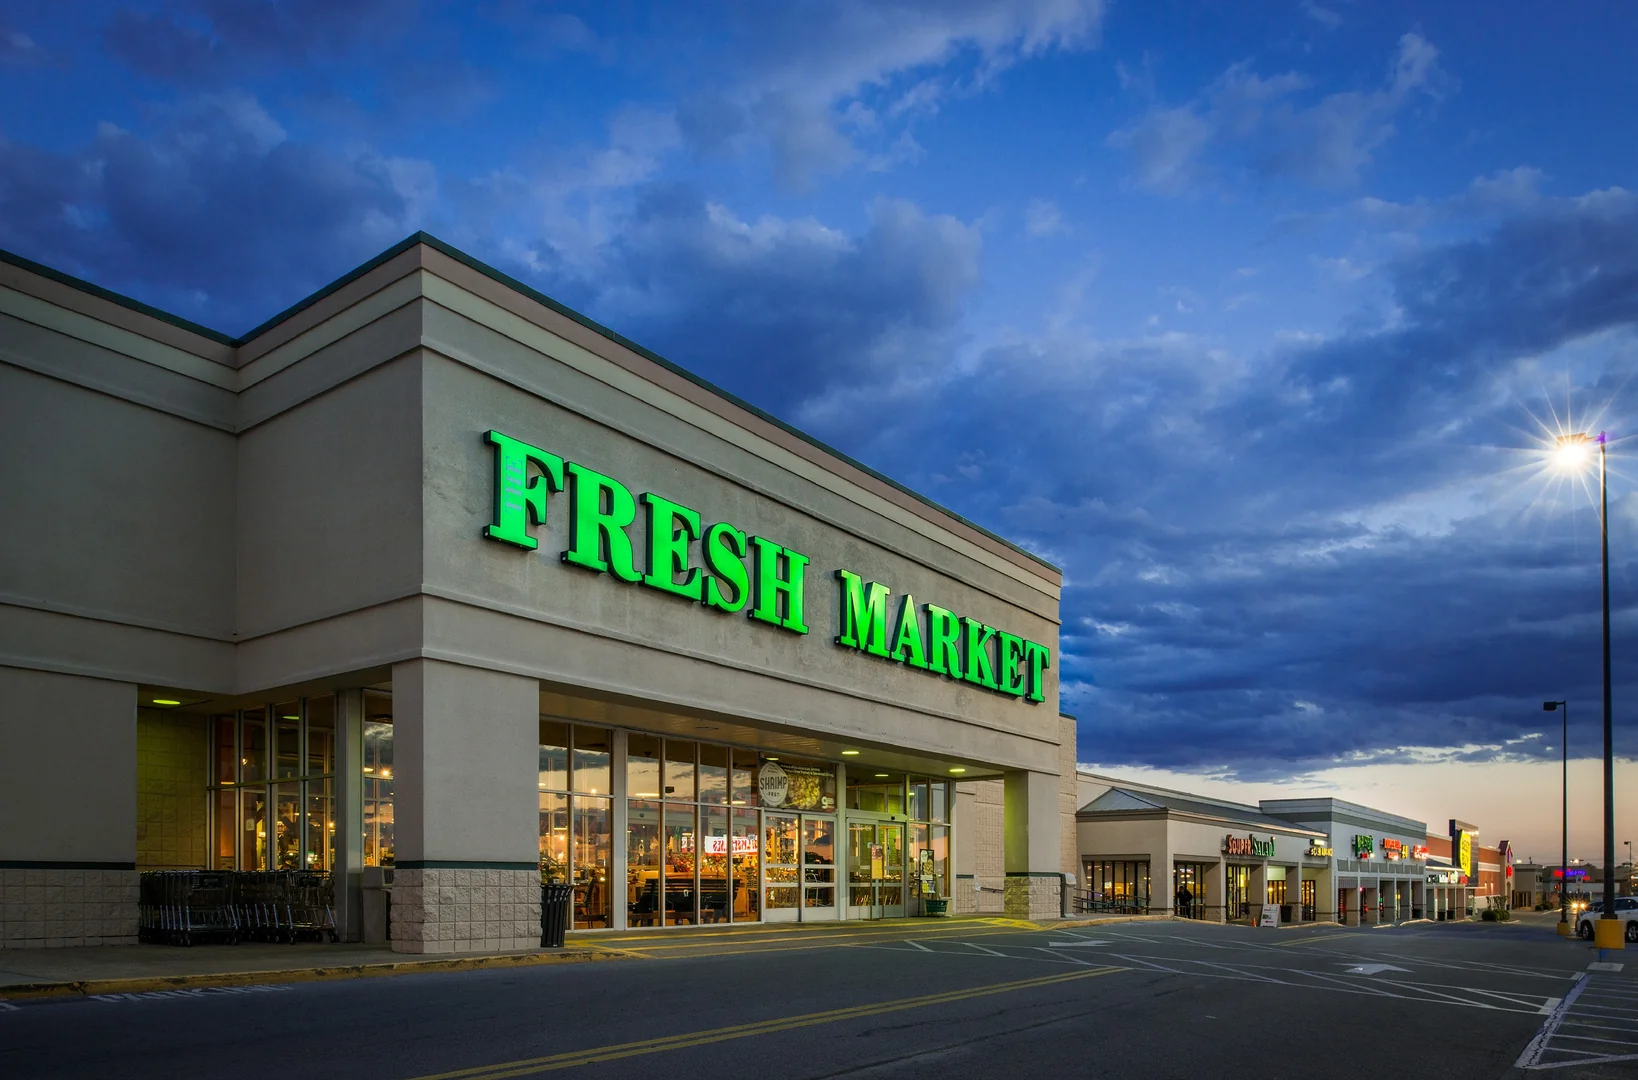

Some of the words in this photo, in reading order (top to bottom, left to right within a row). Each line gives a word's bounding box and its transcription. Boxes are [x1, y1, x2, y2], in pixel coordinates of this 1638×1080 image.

[484, 429, 810, 635] FRESH
[834, 568, 1050, 703] MARKET
[759, 776, 788, 790] SHRIMP
